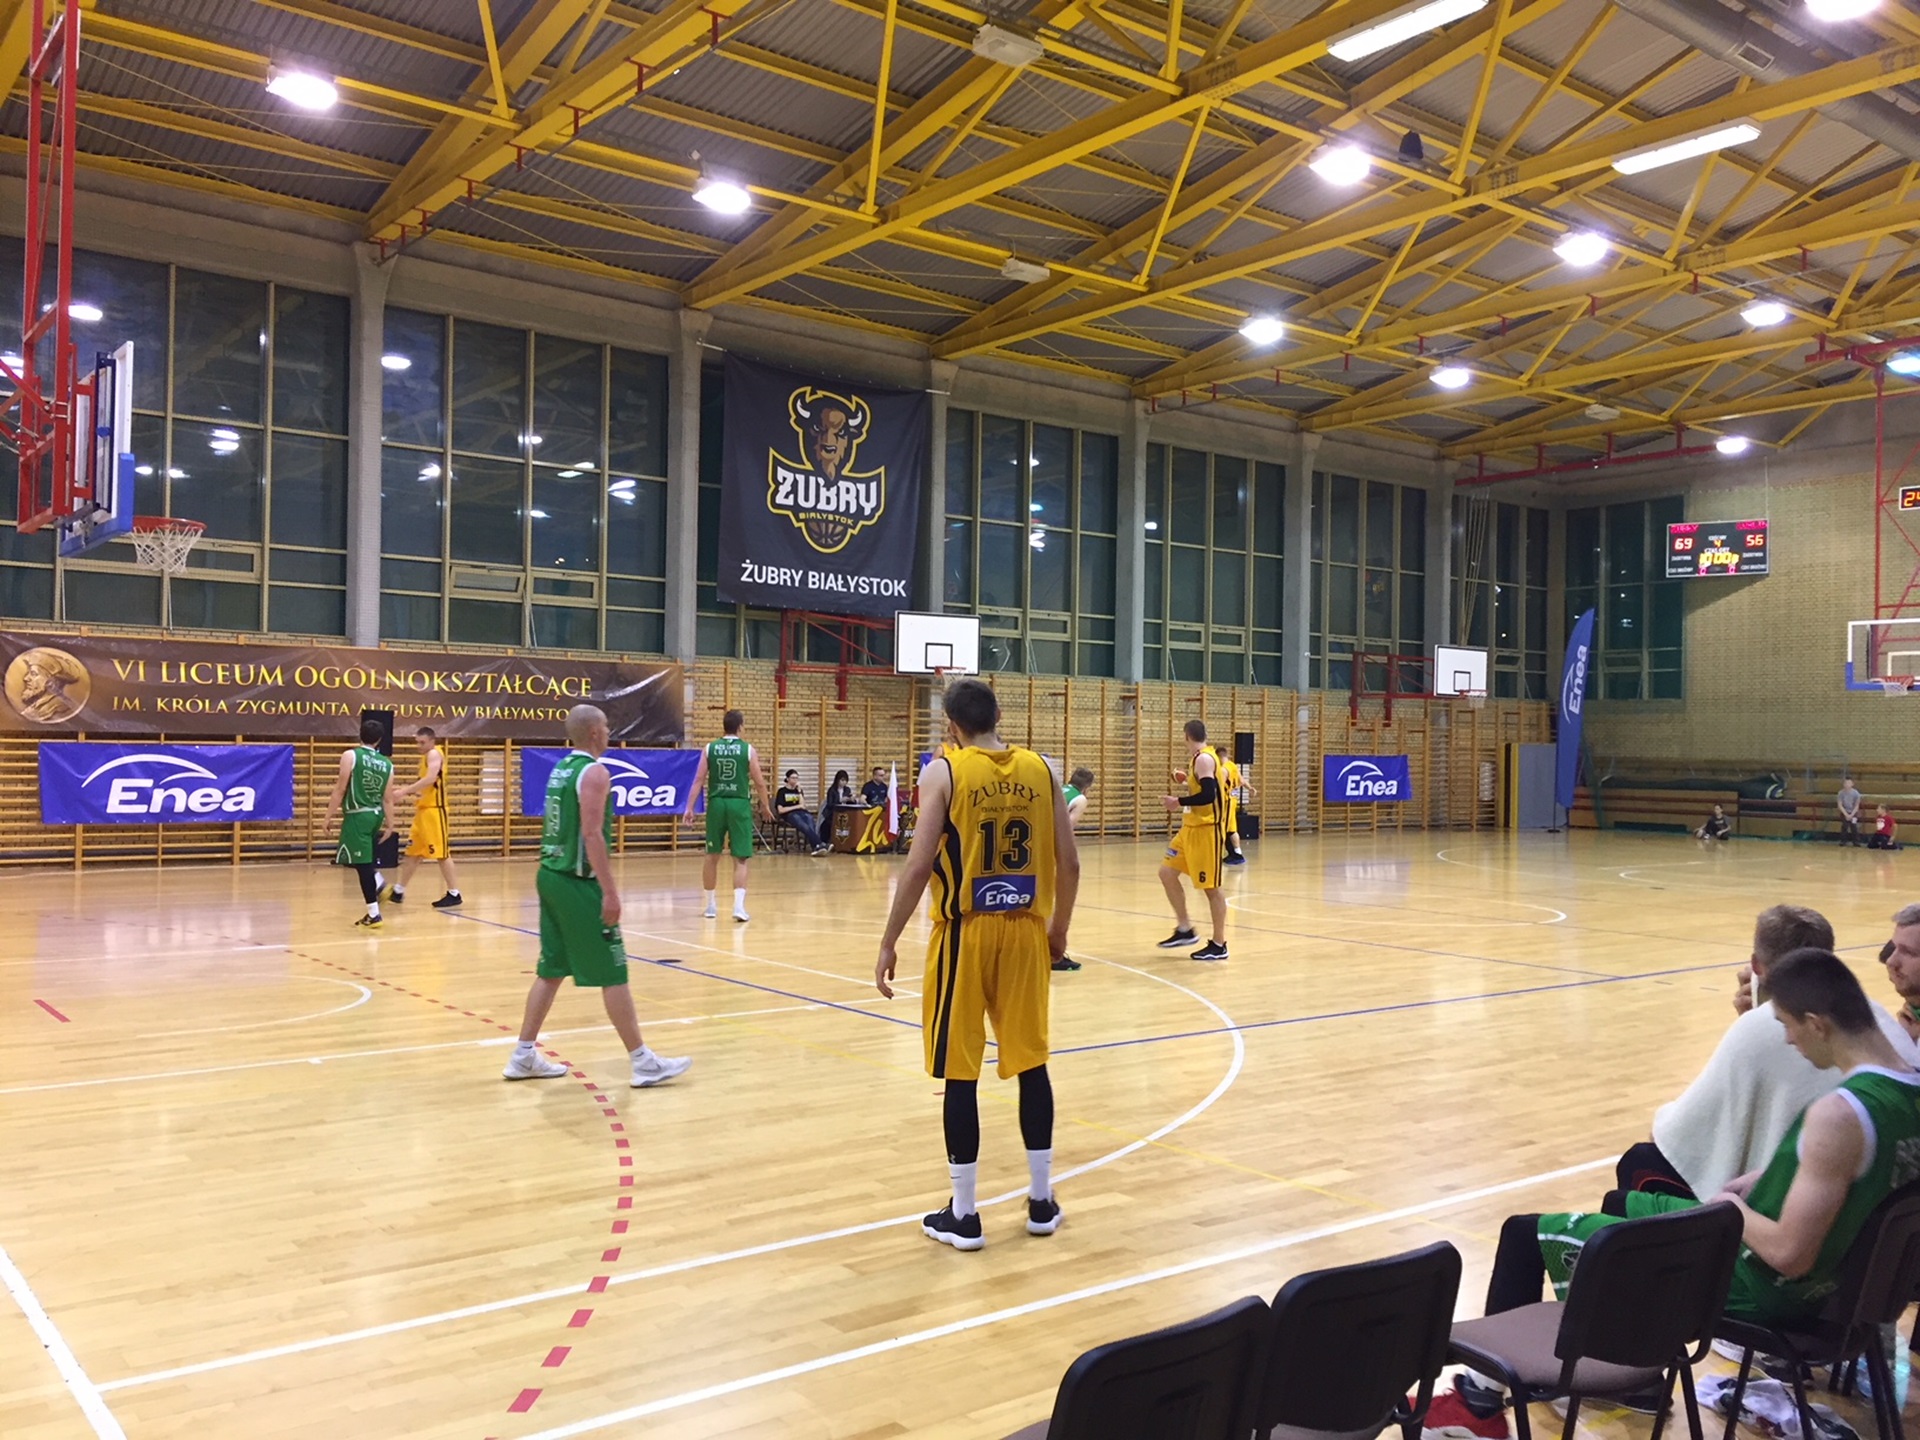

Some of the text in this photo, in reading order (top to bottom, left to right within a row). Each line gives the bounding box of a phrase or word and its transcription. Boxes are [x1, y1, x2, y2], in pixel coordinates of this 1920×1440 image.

[1674, 537, 1694, 550] 69
[1746, 534, 1764, 546] 56
[740, 559, 907, 598] ŻUBRY BIAŁYSTOK
[111, 658, 593, 701] VI LICEUM OGÓLNOKSZTAŁCĄCE
[1568, 644, 1588, 715] Enea
[112, 696, 147, 712] IM.
[156, 694, 229, 714] KRÓLA
[235, 699, 351, 717] ZYGMUNTA
[450, 704, 468, 718] W
[475, 705, 569, 721] BIAŁYMSTO
[716, 758, 737, 780] 13
[106, 778, 256, 814] Enea
[610, 784, 676, 808] nea
[968, 781, 1040, 808] ŻUBRY
[1345, 774, 1398, 796] Enea
[428, 844, 435, 854] 5
[977, 816, 1032, 874] 13
[1198, 871, 1206, 883] 6
[985, 890, 1031, 906] Enea
